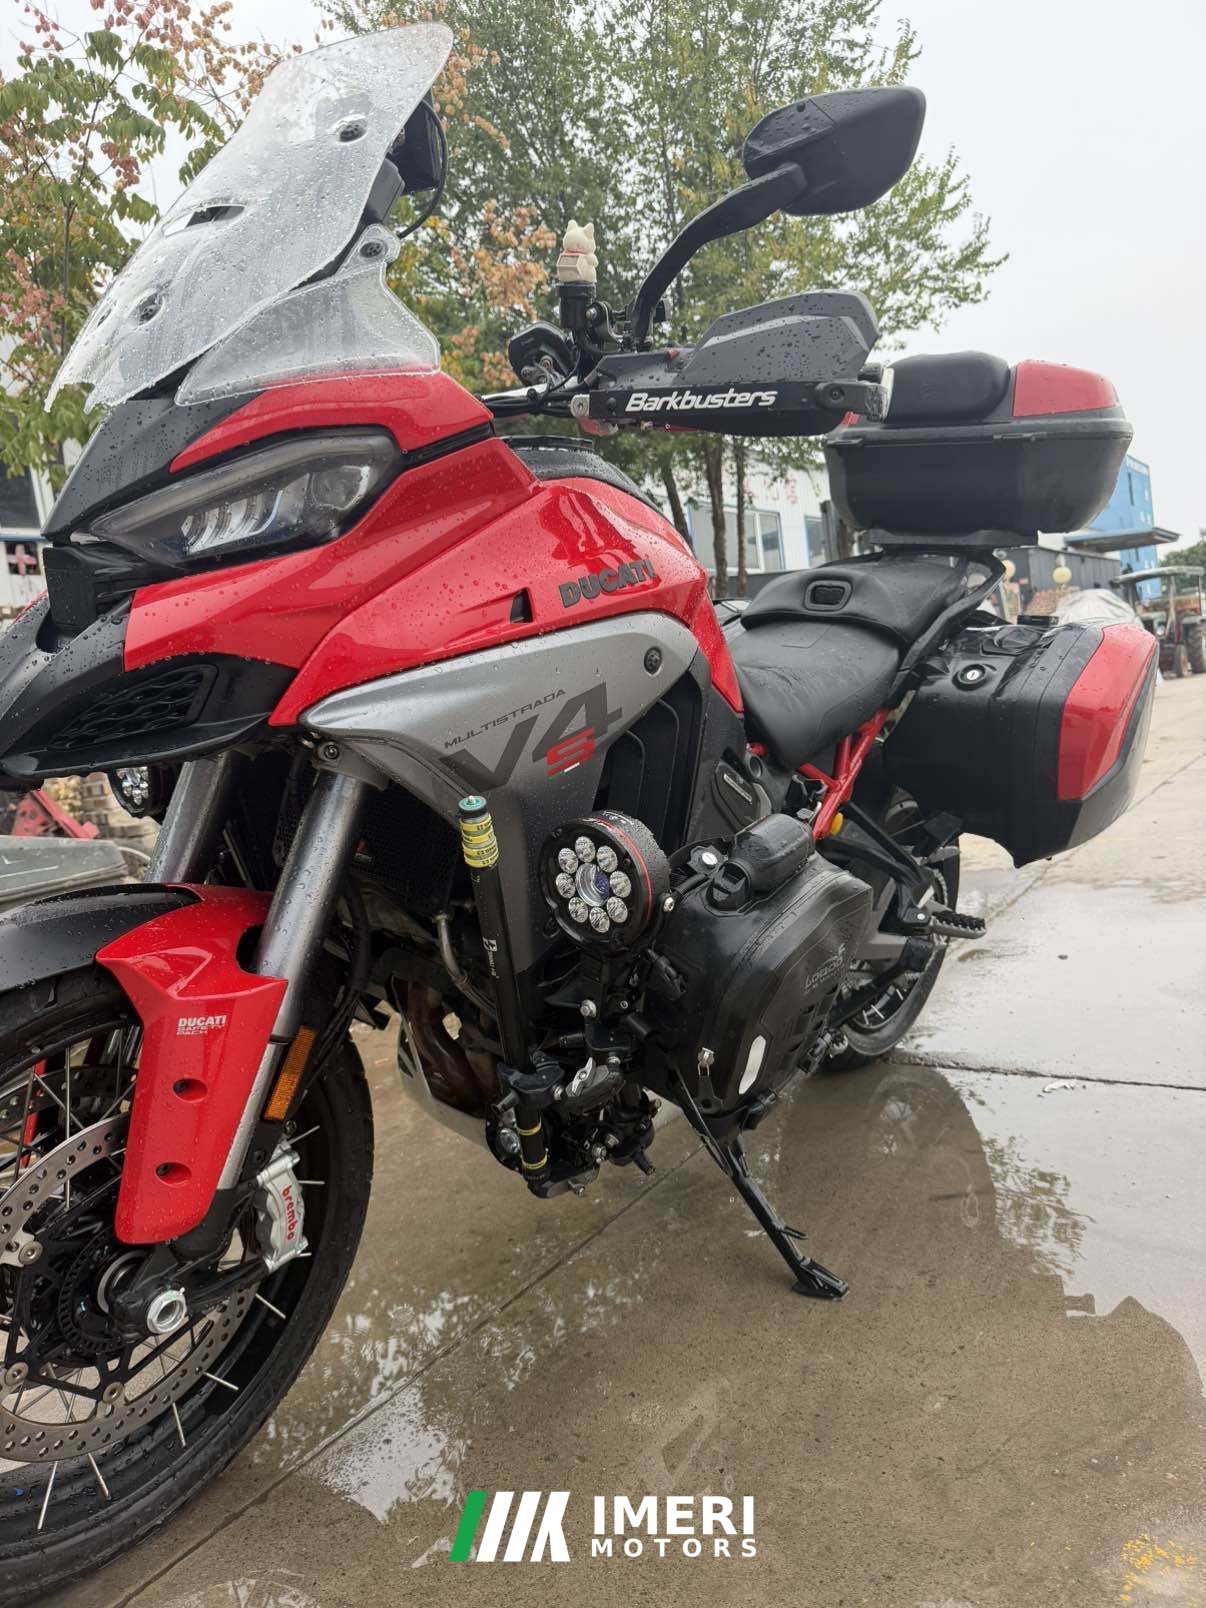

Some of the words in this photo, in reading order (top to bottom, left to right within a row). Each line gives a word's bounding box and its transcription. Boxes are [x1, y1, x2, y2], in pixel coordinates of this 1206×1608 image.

[625, 388, 778, 412] Barkbusters
[559, 560, 656, 608] DUCATI
[445, 689, 566, 749] MULTISTRADA
[177, 1015, 227, 1027] DUCATI
[282, 1184, 298, 1241] brembo
